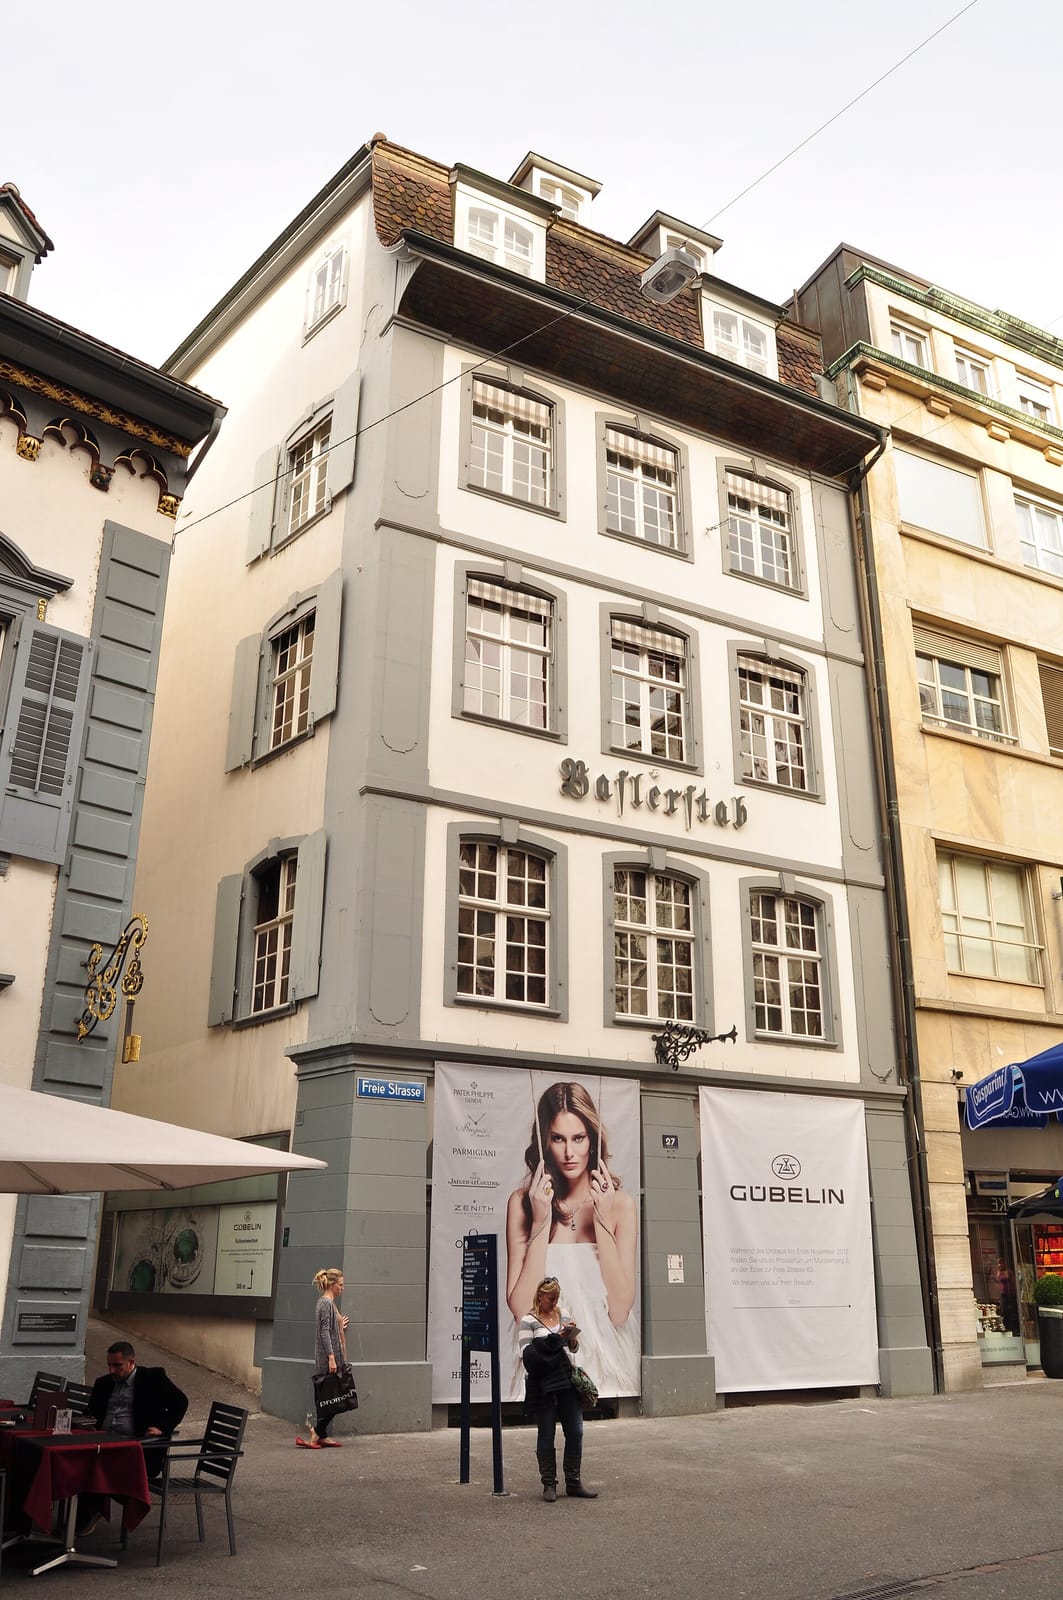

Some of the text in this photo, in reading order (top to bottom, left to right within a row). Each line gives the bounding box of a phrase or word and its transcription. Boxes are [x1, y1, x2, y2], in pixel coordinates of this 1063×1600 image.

[362, 1080, 421, 1098] Freie Strasse
[972, 1069, 1005, 1106] Gasparini
[453, 1088, 495, 1099] PATEK PHILIPPE
[665, 1137, 675, 1146] 27
[452, 1147, 496, 1157] PARMIGIANI
[730, 1185, 845, 1204] GÜBELIN
[454, 1204, 494, 1212] ZENITH
